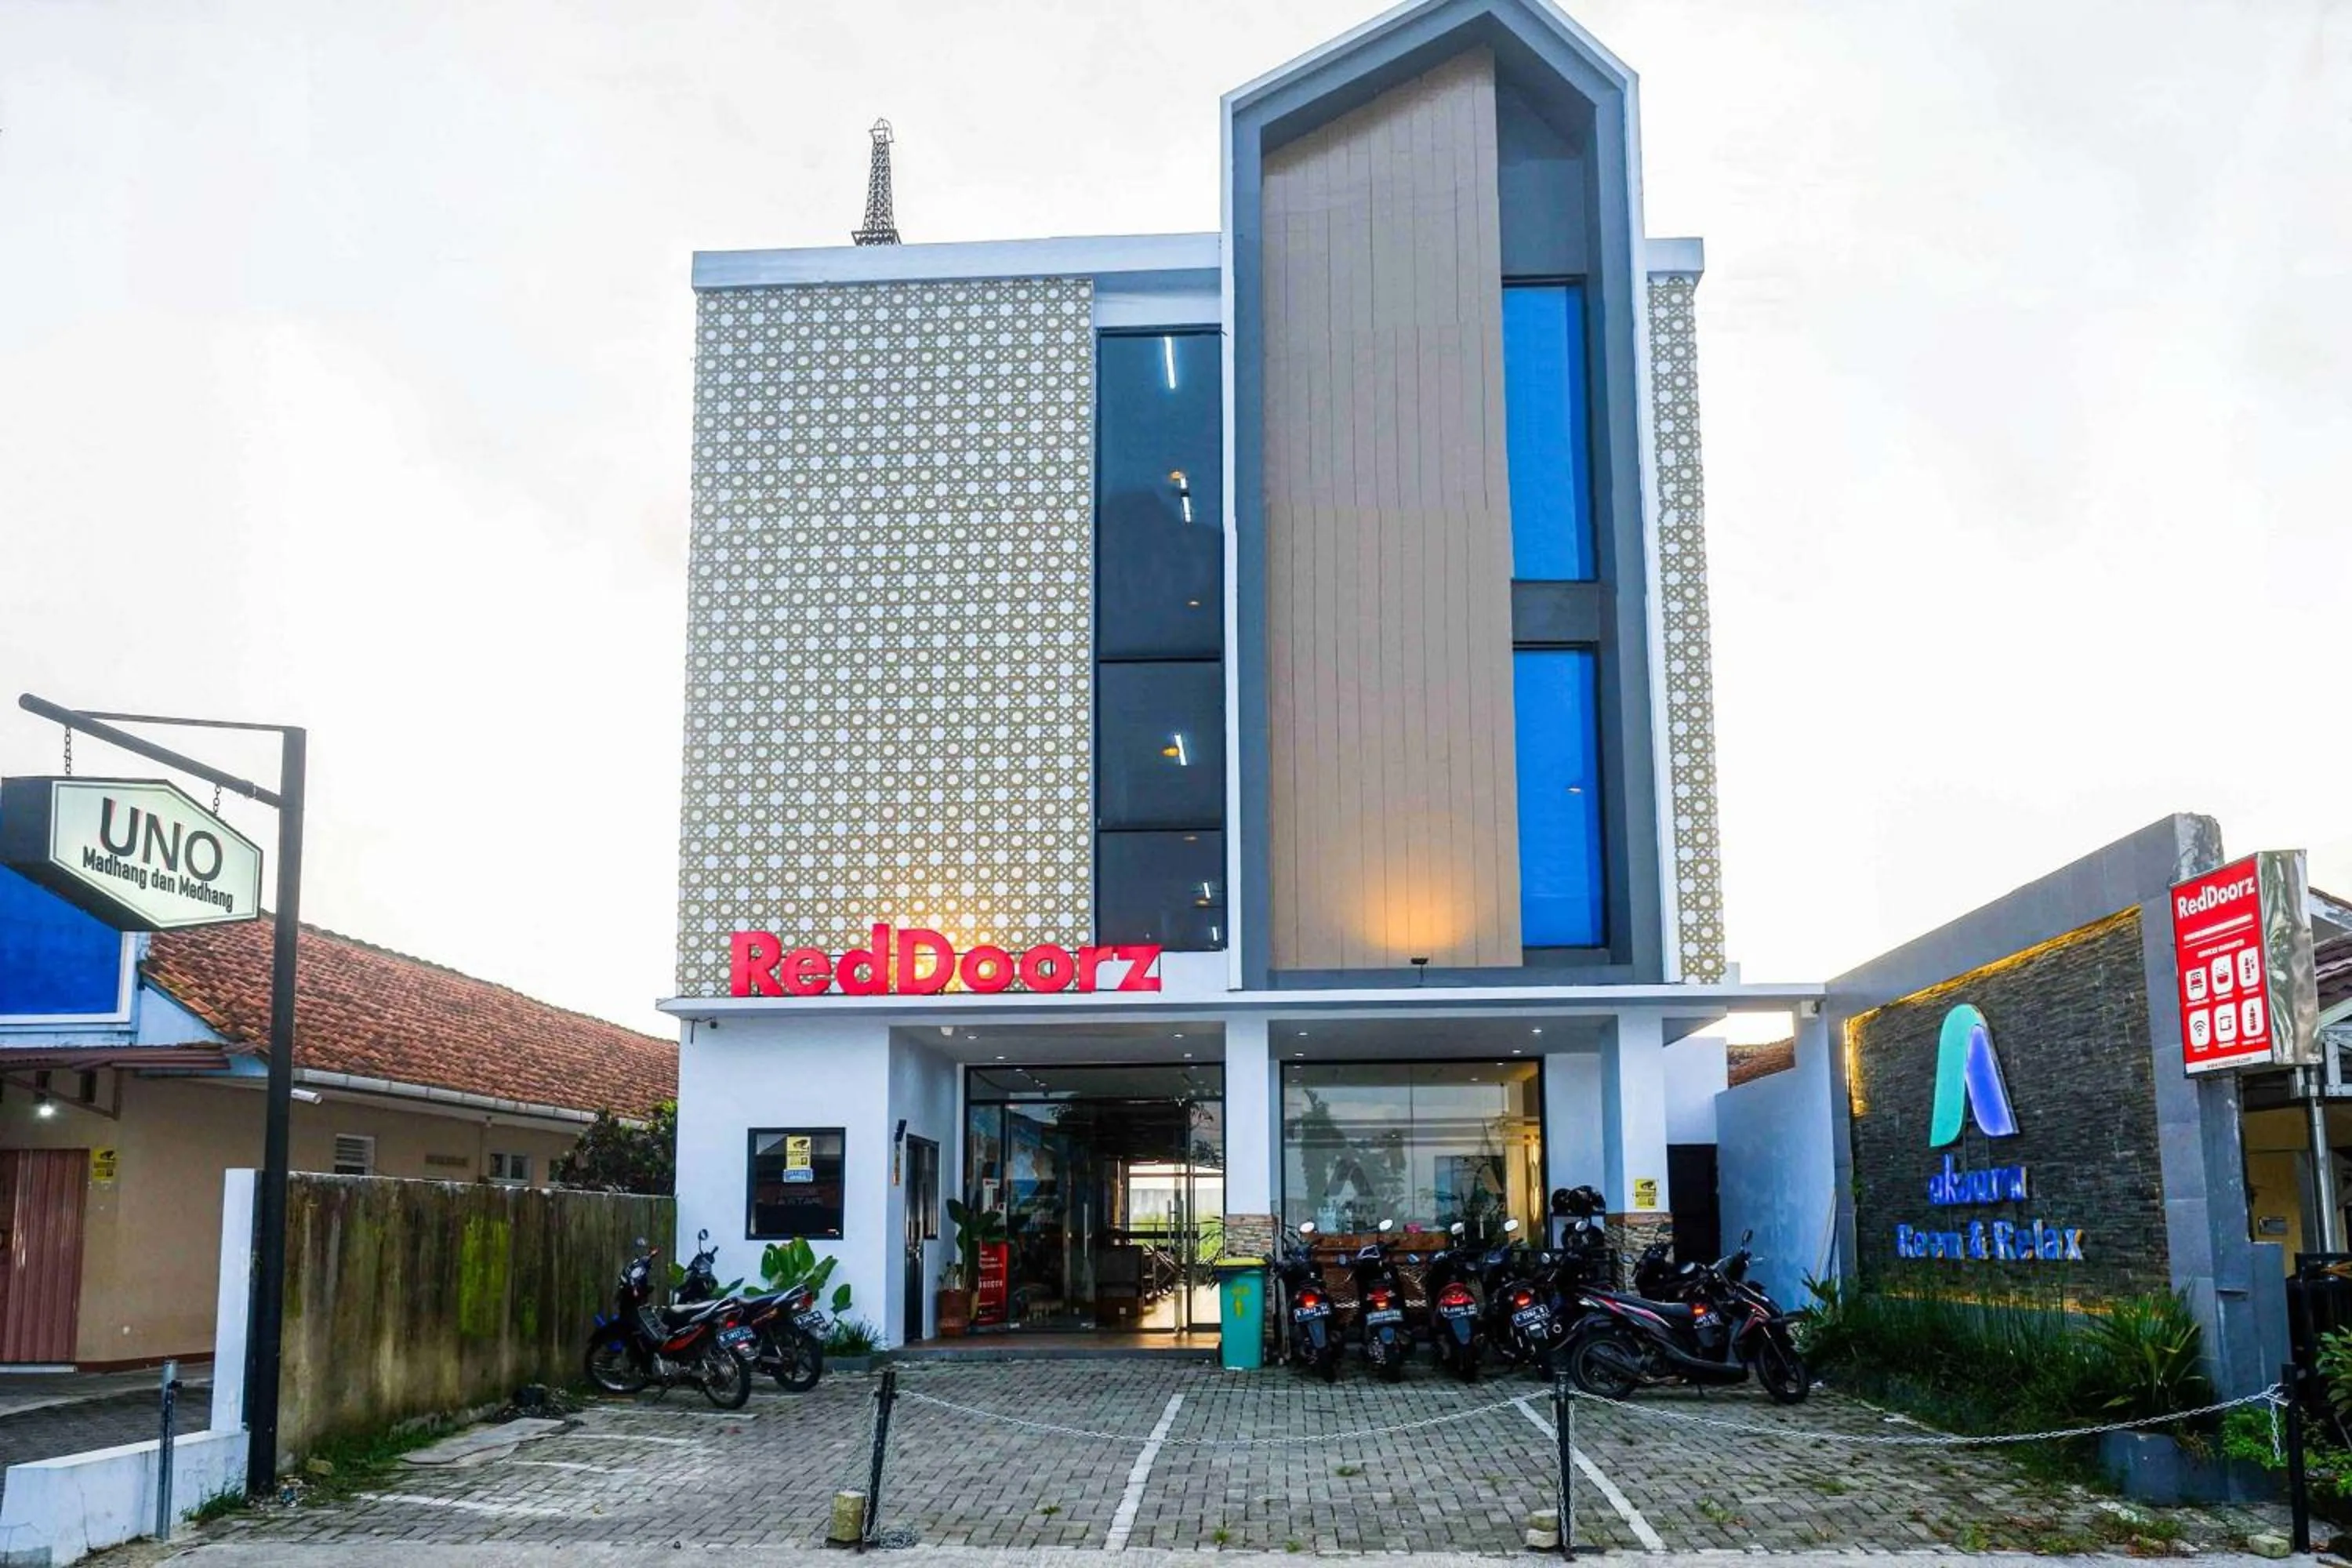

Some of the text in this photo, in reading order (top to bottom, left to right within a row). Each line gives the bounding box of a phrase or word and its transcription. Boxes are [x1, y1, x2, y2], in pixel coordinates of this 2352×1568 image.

[100, 797, 223, 881] UNO
[83, 846, 147, 890] Madhang
[151, 868, 175, 893] dan
[2177, 876, 2256, 919] RedDoorz
[730, 923, 1163, 996] RedDoorz
[1991, 1218, 2084, 1260] Relax
